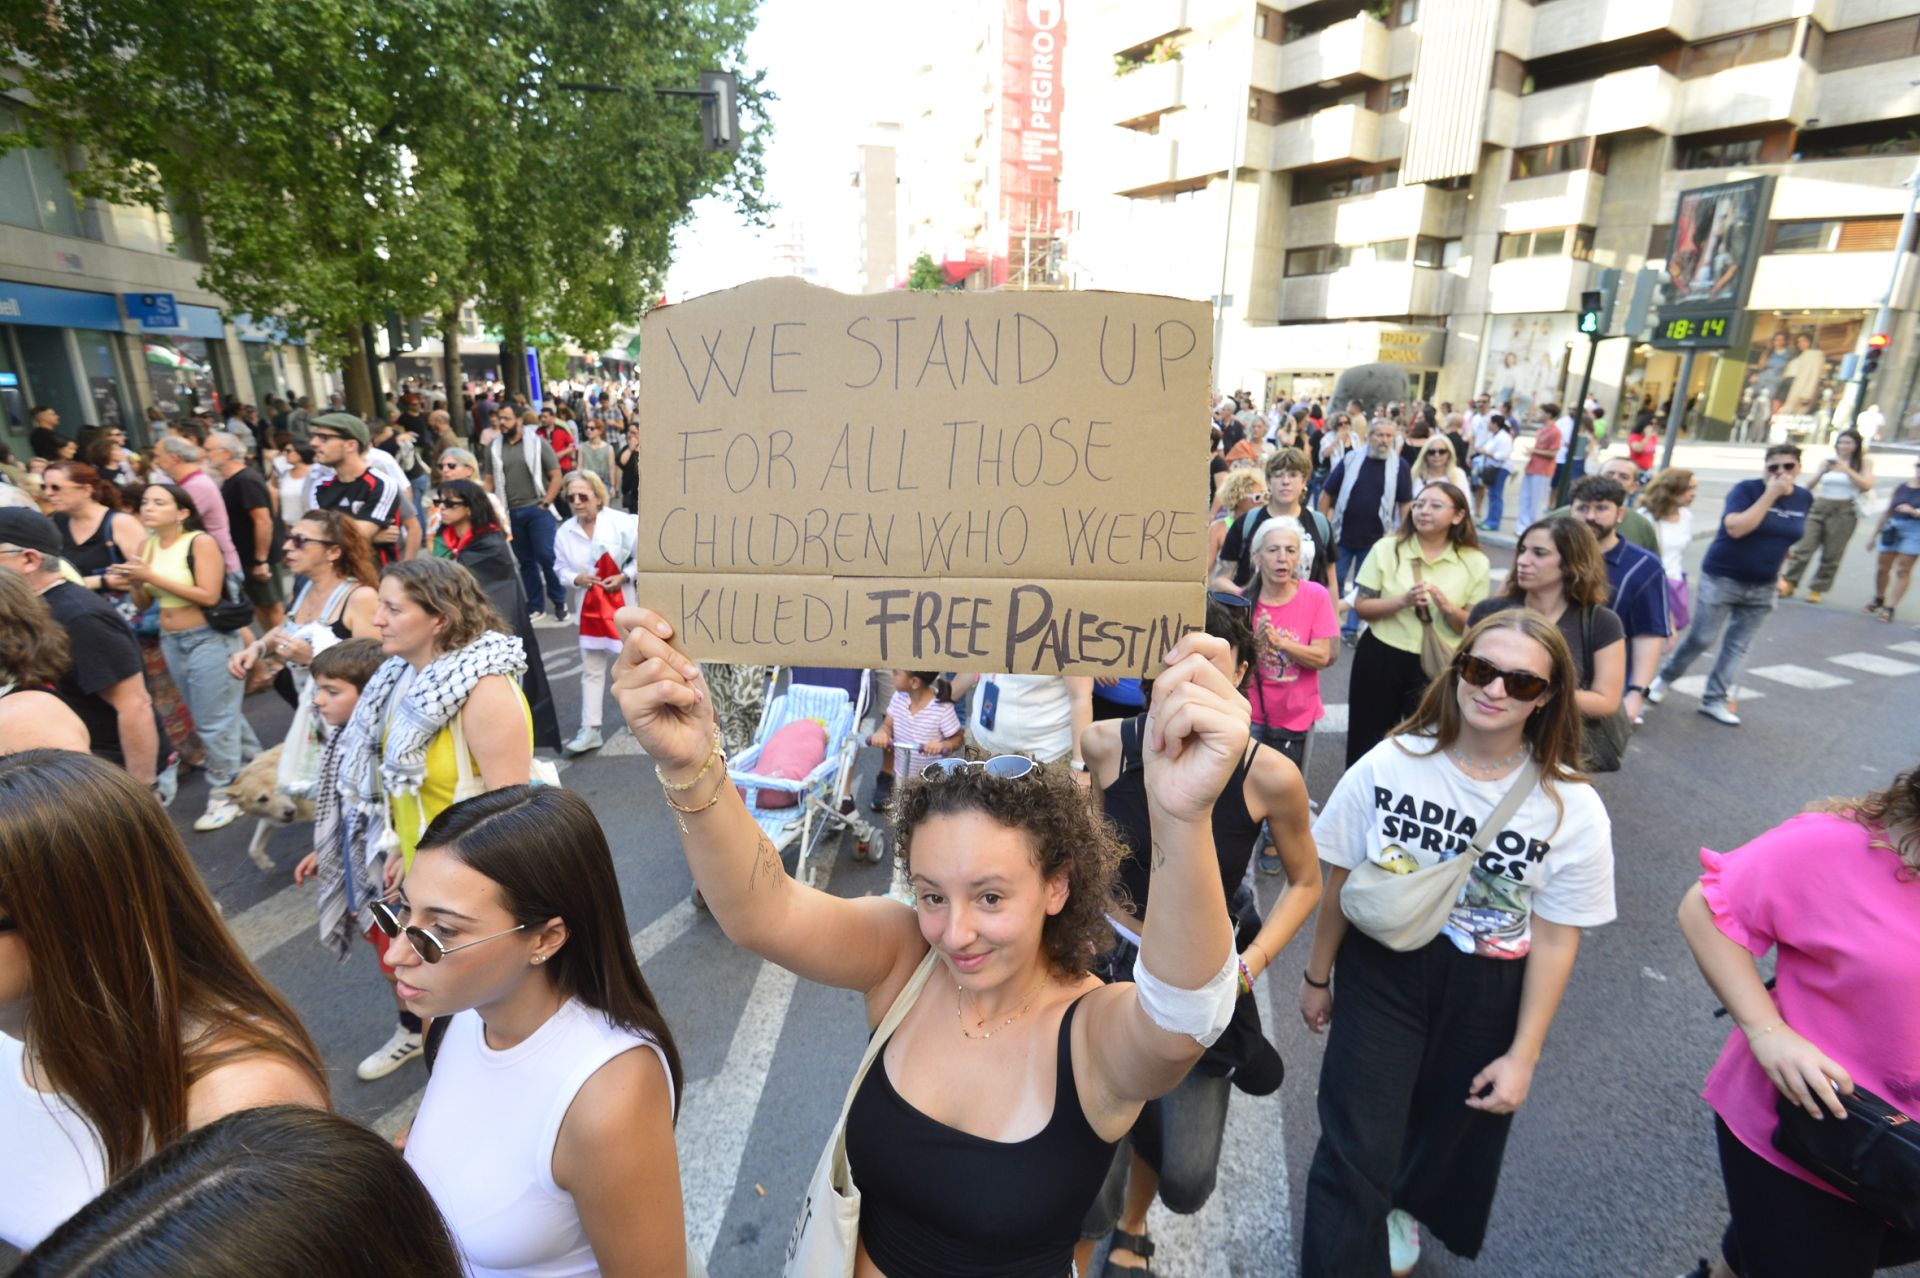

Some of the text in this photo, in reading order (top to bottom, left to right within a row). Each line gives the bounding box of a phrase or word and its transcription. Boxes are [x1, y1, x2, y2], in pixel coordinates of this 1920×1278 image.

[1030, 31, 1054, 129] PEGIRO
[666, 312, 1197, 404] WE STAND UP
[1666, 318, 1726, 340] 18:14
[677, 417, 1113, 494] FOR ALL THOSE
[658, 505, 1199, 572] CHILDREN WHO WERE
[681, 584, 850, 647] KILLED!
[865, 588, 993, 661] FREE
[1374, 785, 1552, 864] RADIAOR
